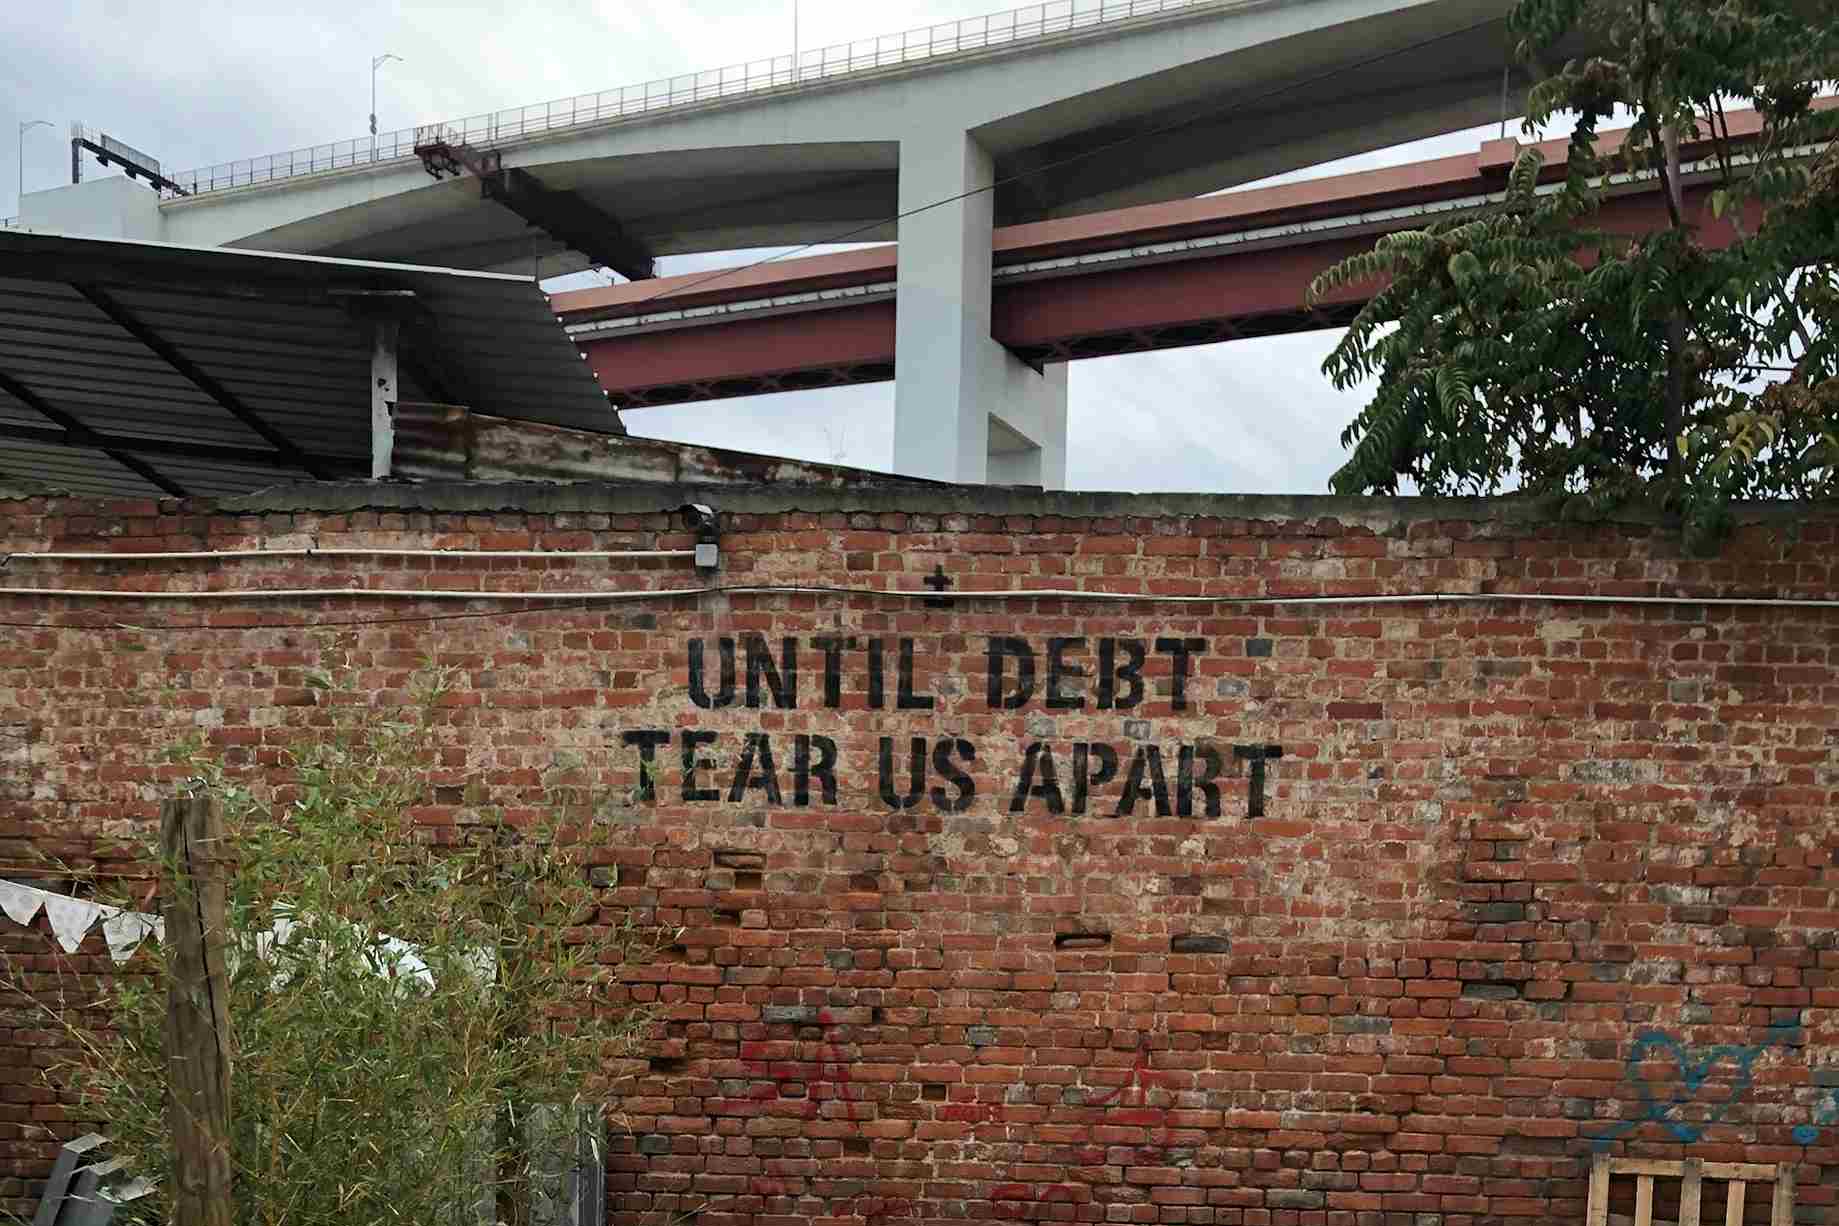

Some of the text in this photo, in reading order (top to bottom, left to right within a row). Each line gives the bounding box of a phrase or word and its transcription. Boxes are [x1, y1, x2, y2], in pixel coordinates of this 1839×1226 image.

[688, 633, 1207, 711] UNTIL DEBT
[623, 730, 1284, 819] TEAR US APART
